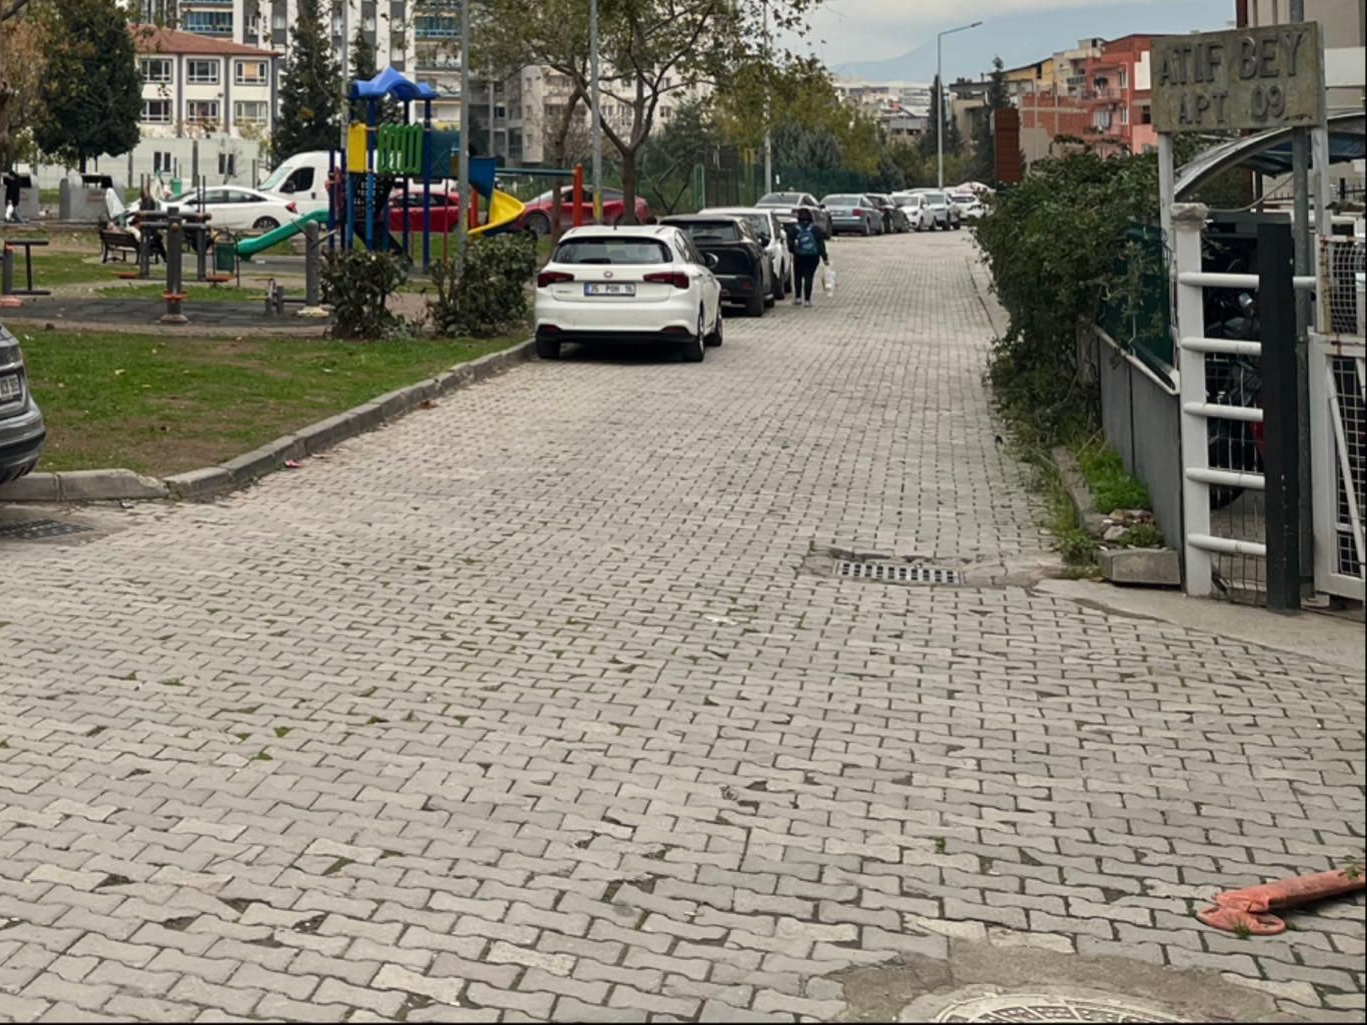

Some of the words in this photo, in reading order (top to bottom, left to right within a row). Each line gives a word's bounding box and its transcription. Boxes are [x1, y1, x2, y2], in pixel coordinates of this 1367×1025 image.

[1238, 31, 1309, 80] BEY
[1179, 89, 1228, 124] APT
[1252, 84, 1286, 120] 09
